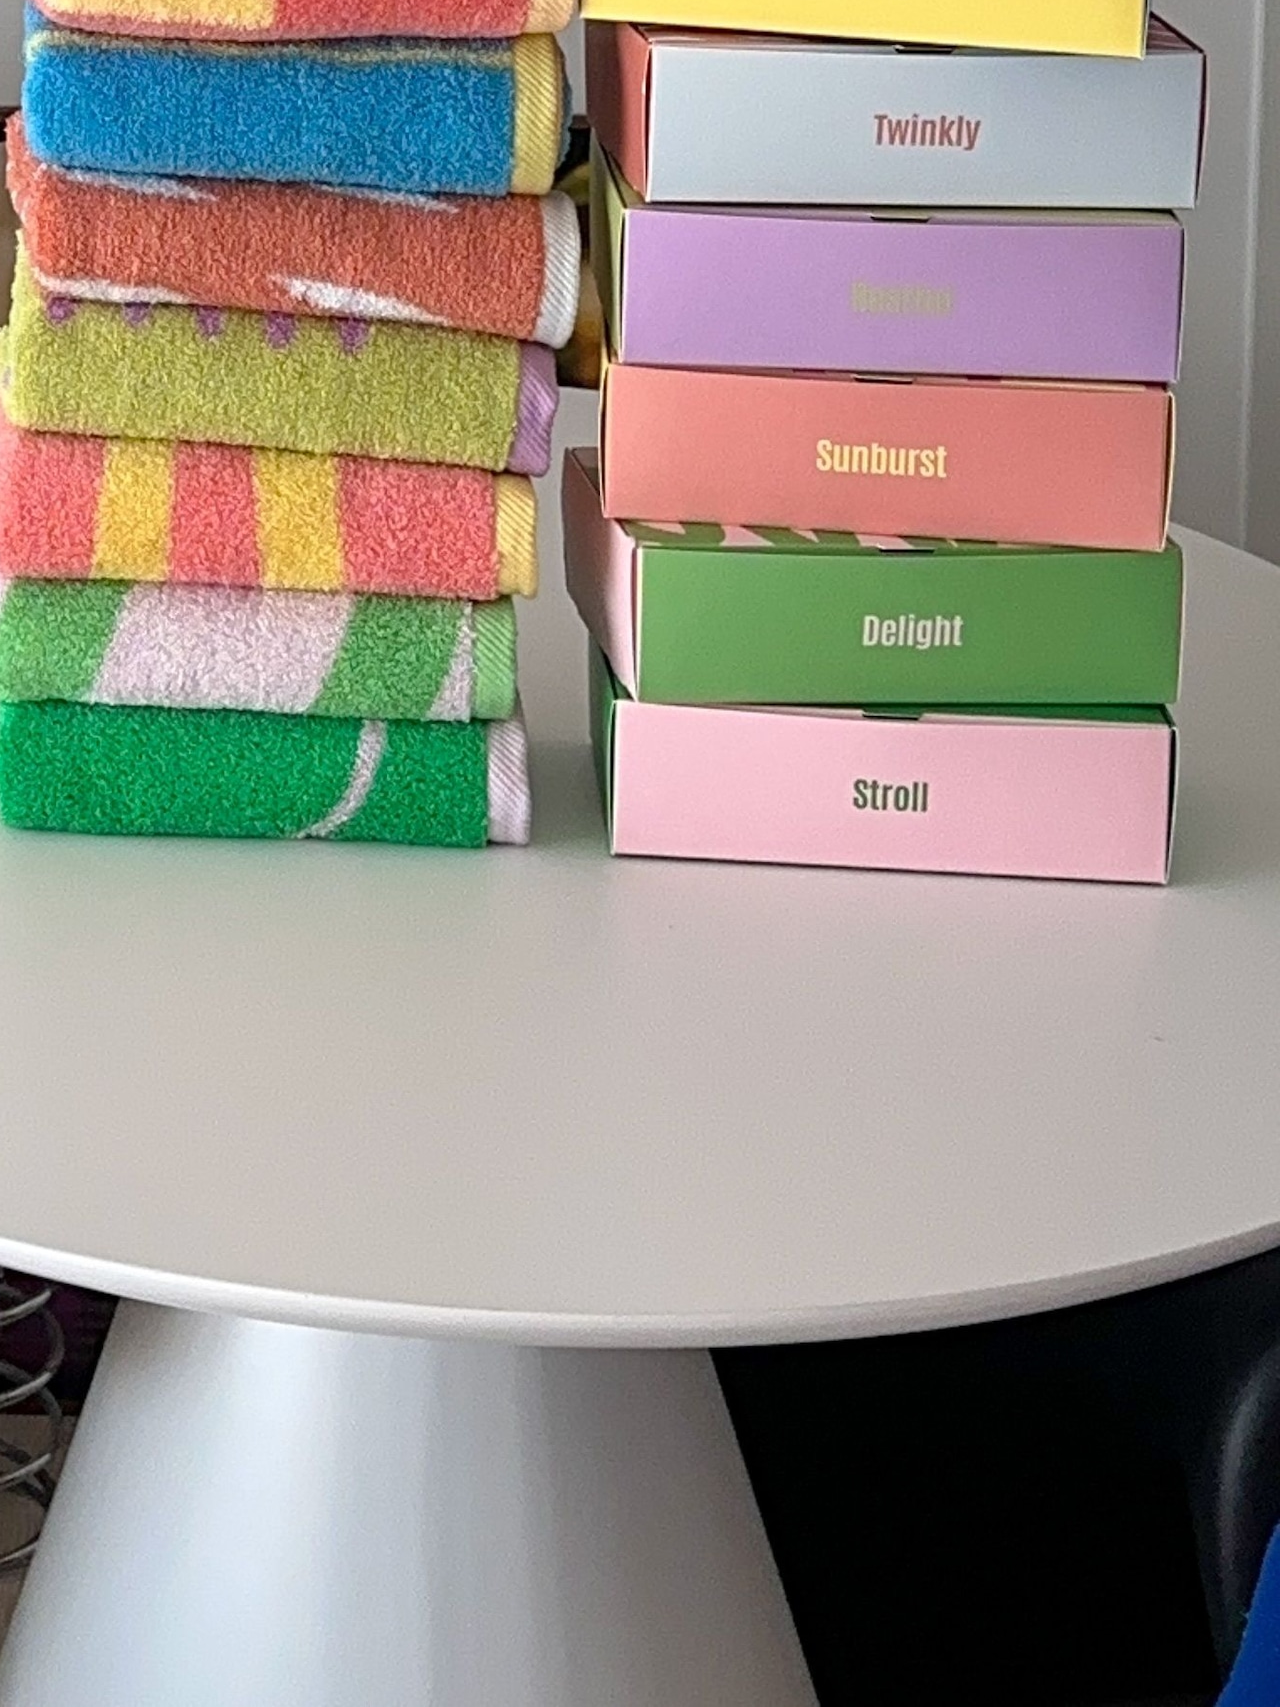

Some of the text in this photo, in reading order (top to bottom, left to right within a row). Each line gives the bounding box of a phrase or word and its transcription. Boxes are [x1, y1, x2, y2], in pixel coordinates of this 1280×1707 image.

[873, 113, 981, 151] Twinkly
[816, 439, 947, 478] Sunburst
[862, 613, 964, 649] Delight
[852, 778, 930, 812] Stroll
